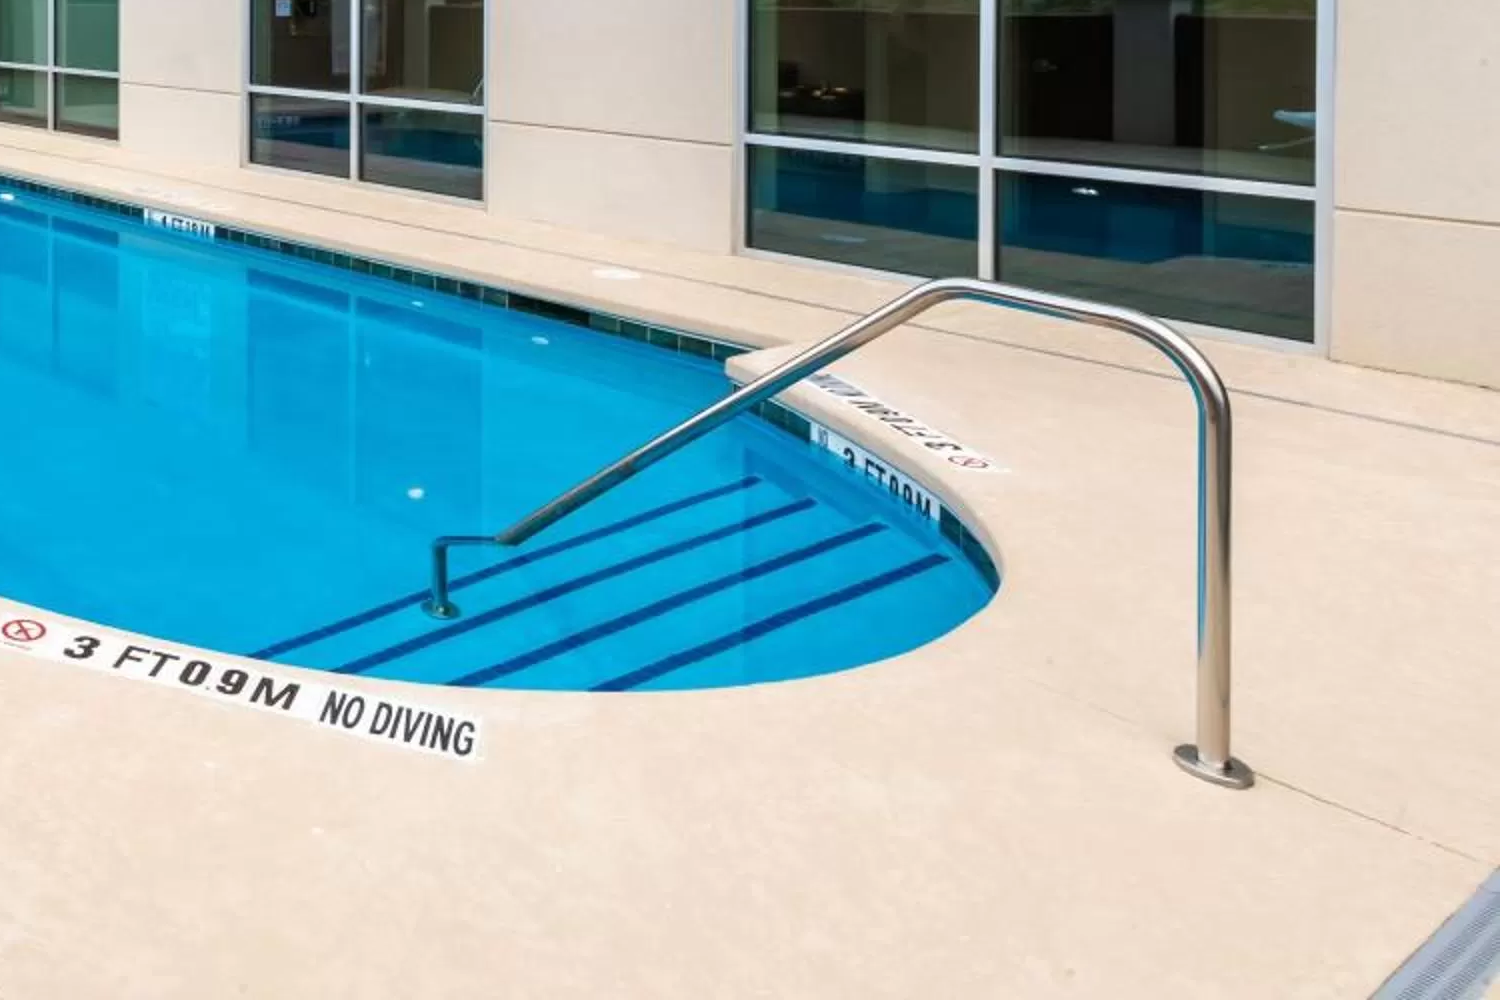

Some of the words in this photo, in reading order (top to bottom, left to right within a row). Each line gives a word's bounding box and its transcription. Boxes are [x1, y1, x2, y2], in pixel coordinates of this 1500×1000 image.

[63, 635, 101, 660] 3
[319, 690, 366, 728] NO
[369, 701, 476, 756] DIVING
